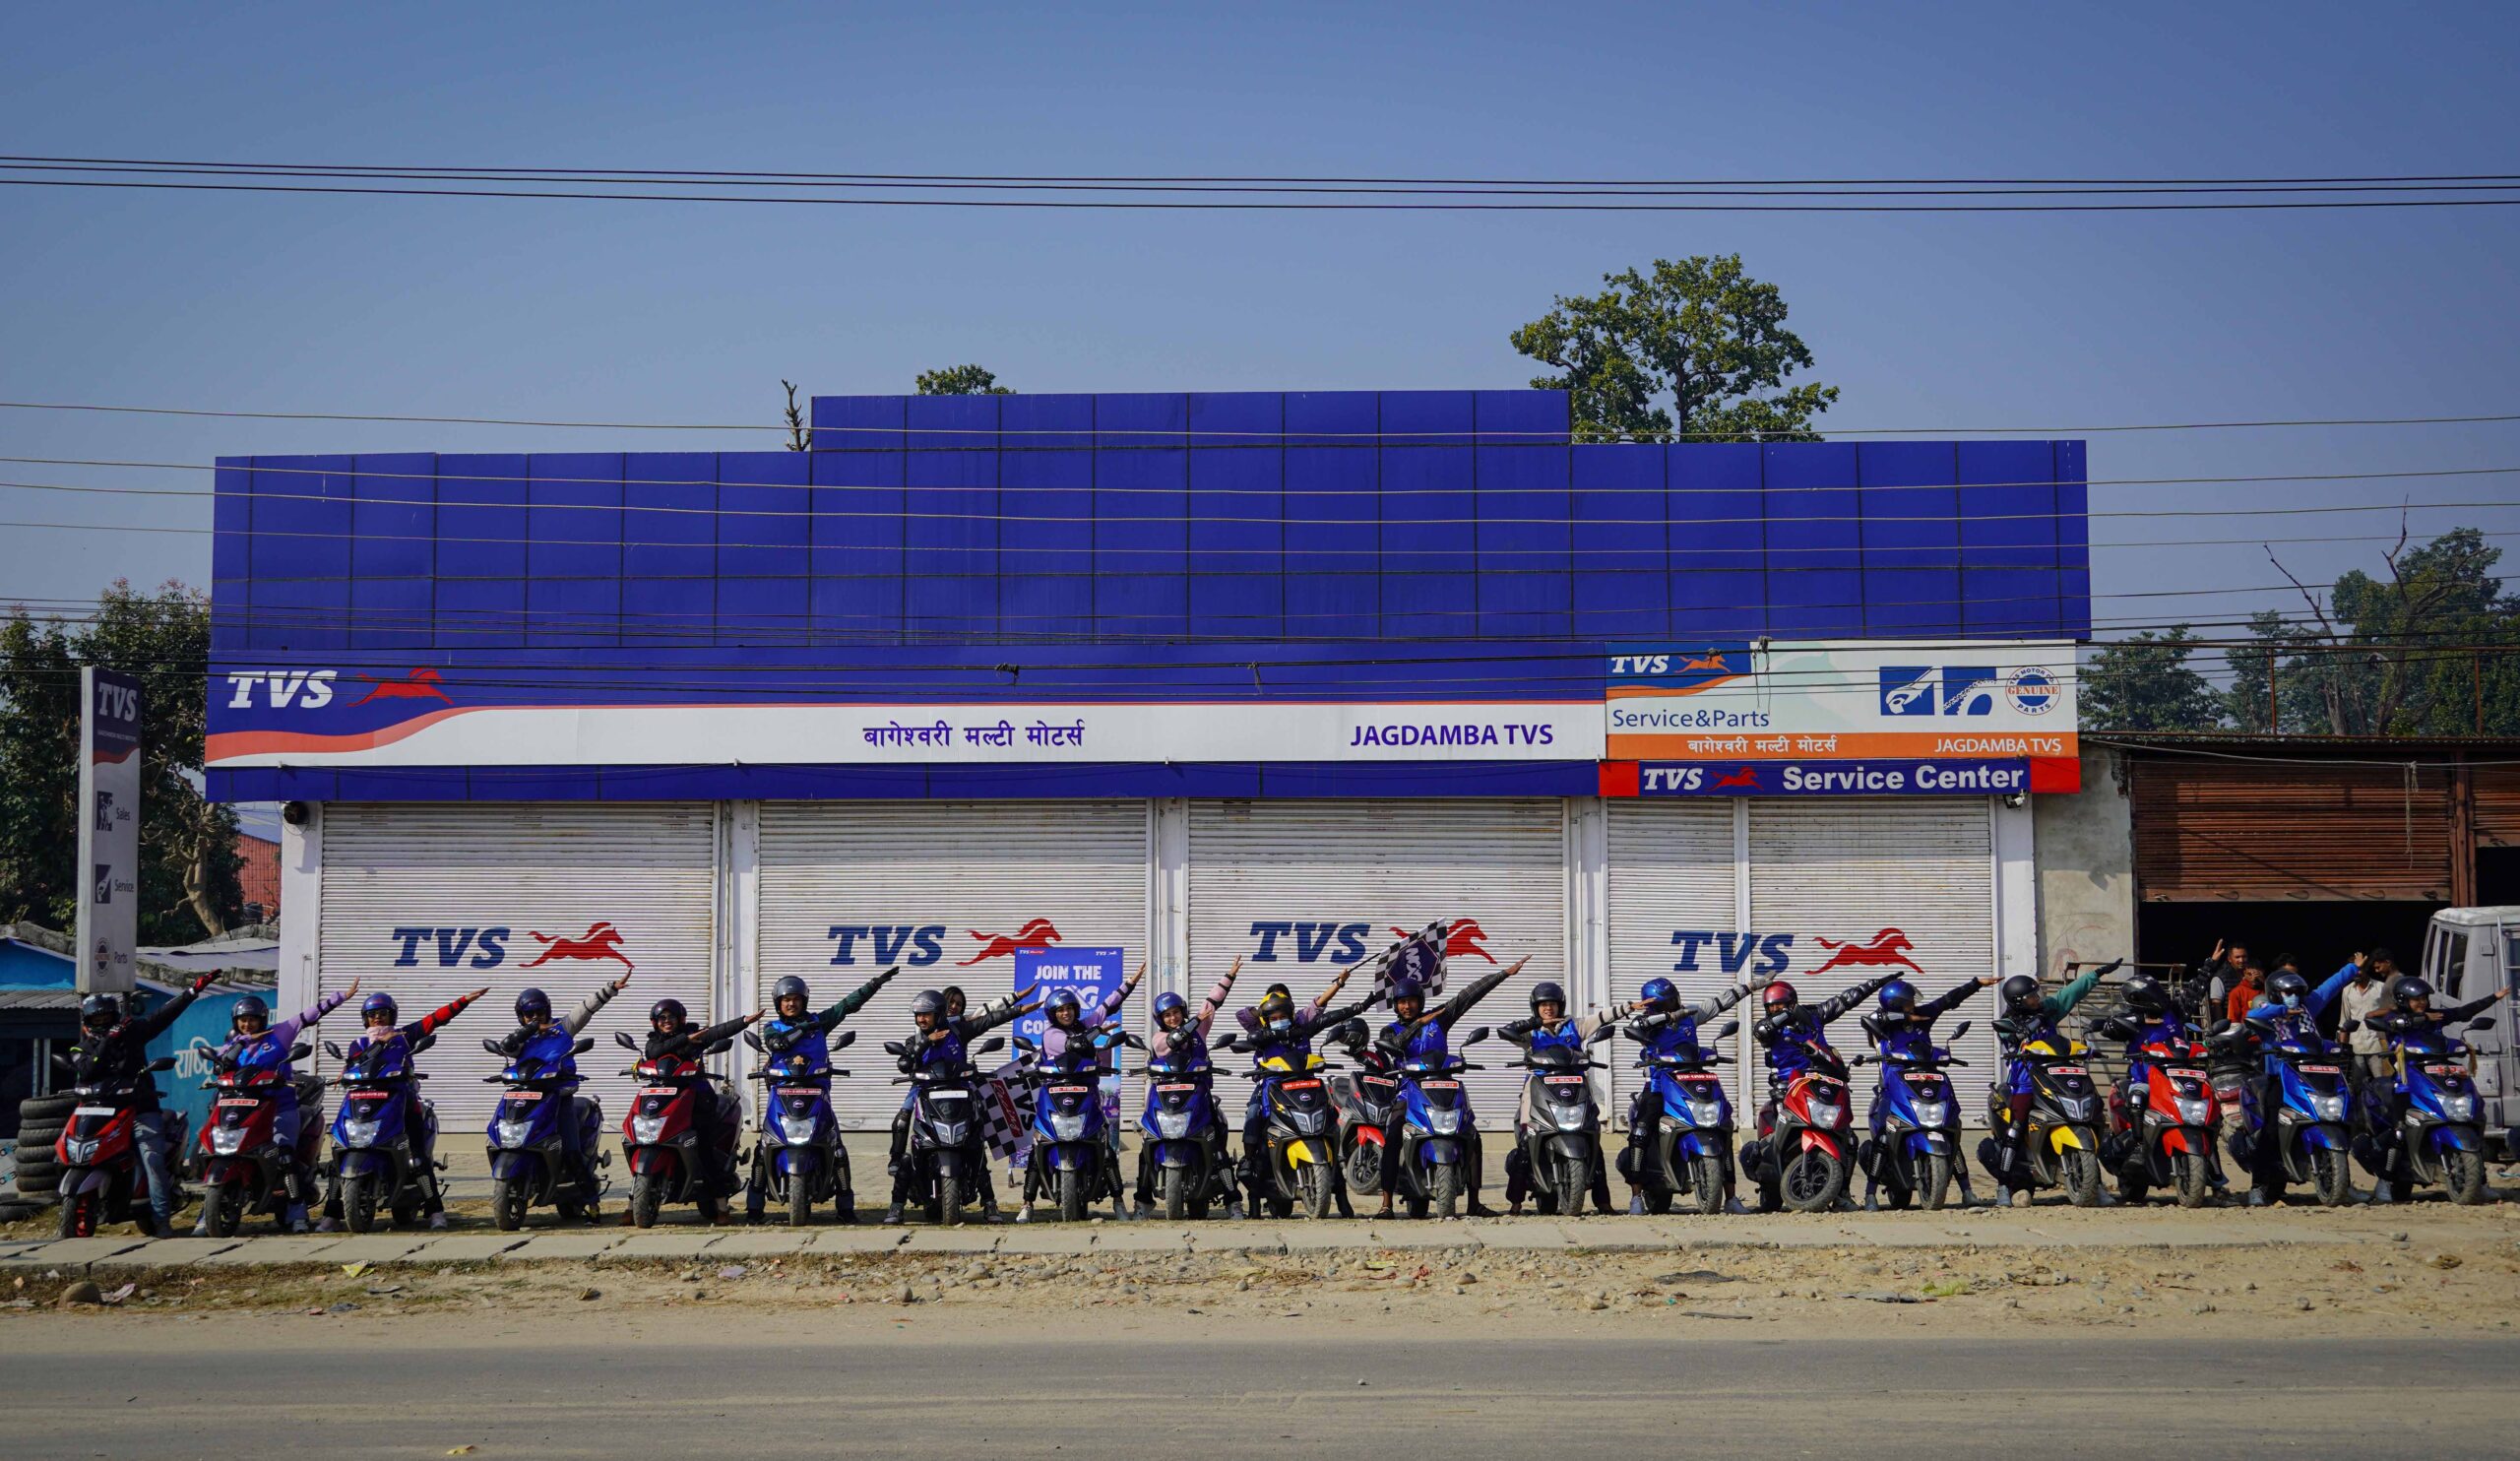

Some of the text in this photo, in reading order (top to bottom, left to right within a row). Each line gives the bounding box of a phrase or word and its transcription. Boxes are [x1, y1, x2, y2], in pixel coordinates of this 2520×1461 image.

[1610, 654, 1670, 673] TVS
[227, 669, 339, 709] TVS
[2007, 685, 2059, 695] GENUINE
[98, 681, 138, 722] TVS
[2017, 703, 2051, 714] PARTS
[1612, 709, 1770, 728] Service&Parts
[862, 719, 1086, 747] बागेश्वरी मल्टी मोटर्स
[1351, 724, 1553, 746] JAGDAMBA TVS
[1687, 735, 1838, 754] बागेश्वरी मल्टी मोटर्स
[1934, 738, 2062, 753] JAGDAMBA TVS
[1643, 764, 2024, 791] TVS Service Center
[115, 806, 131, 821] Sales
[114, 878, 135, 893] Service
[392, 926, 511, 969] TVS
[828, 925, 947, 967] TVS
[1250, 921, 1370, 965] TVS
[1670, 930, 1795, 975] TVS
[114, 951, 128, 964] Parts
[1035, 965, 1102, 981] JOIN THE
